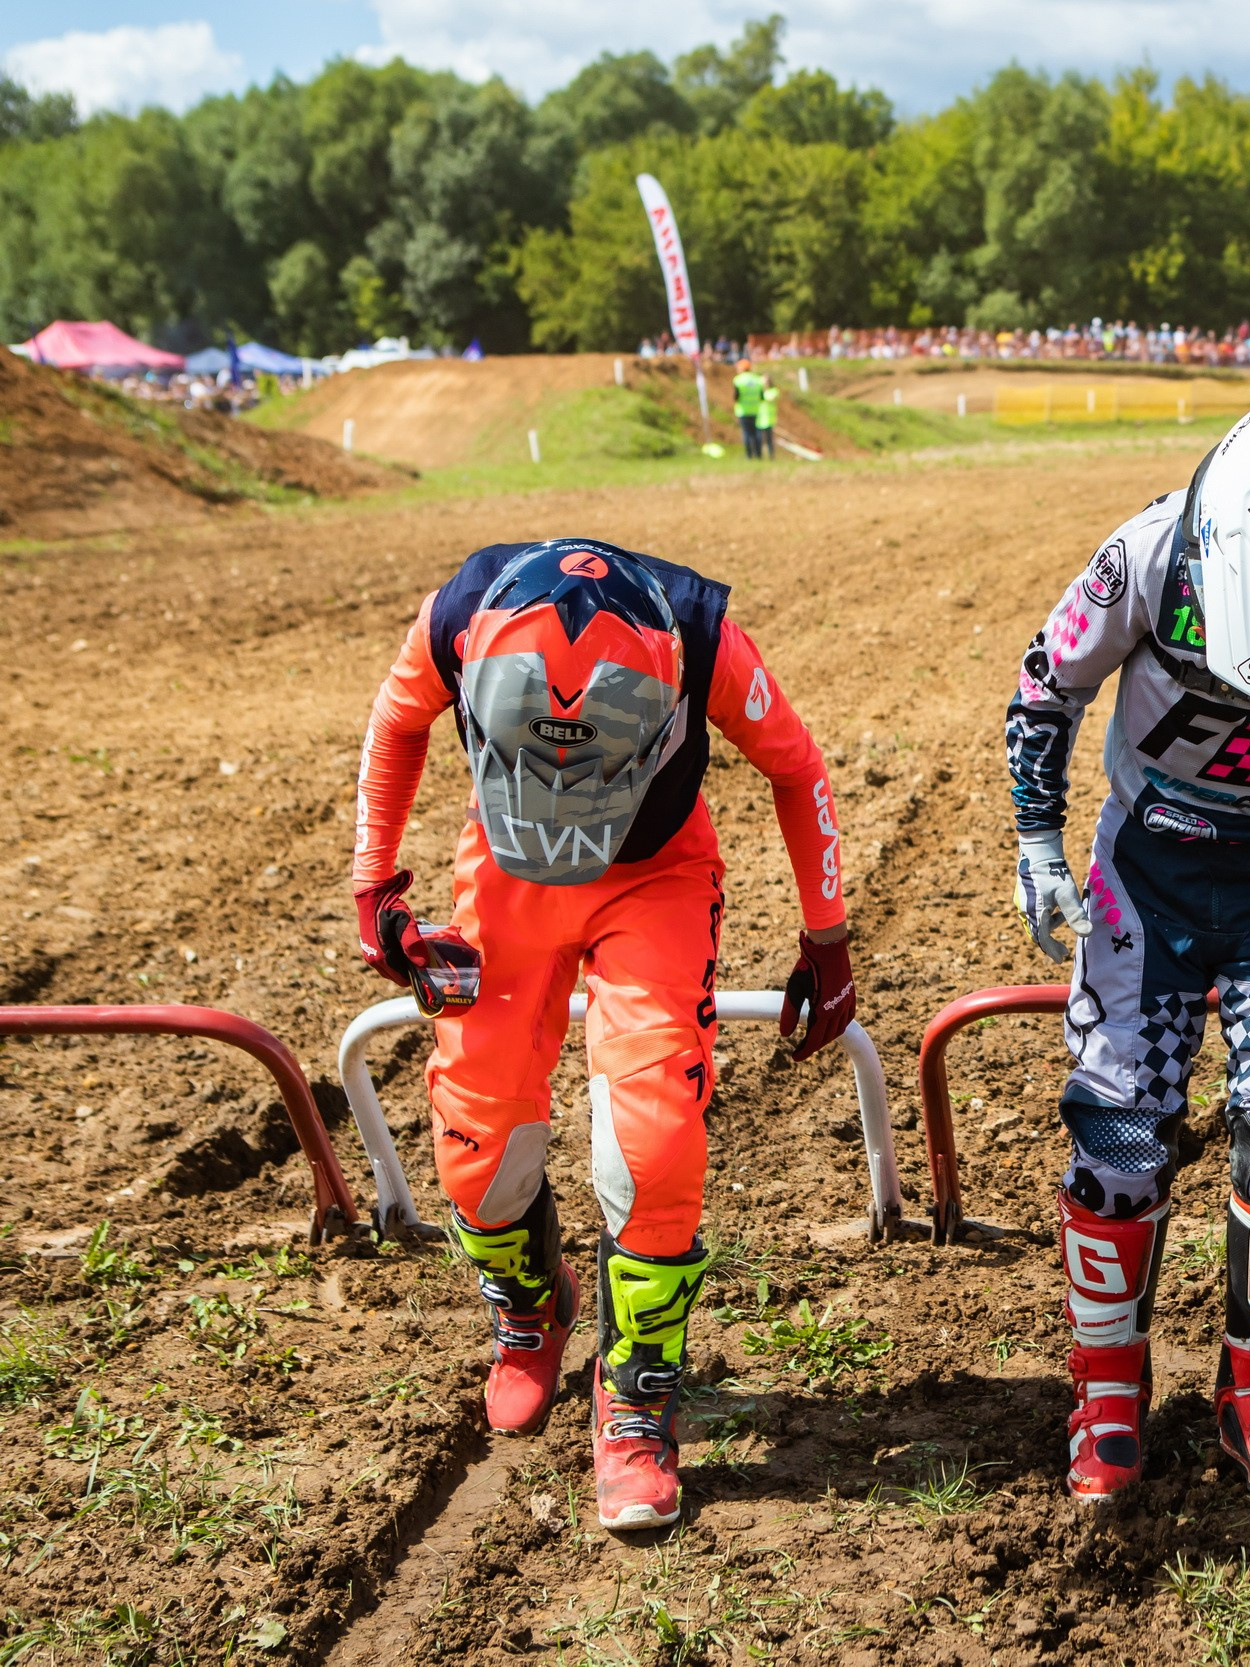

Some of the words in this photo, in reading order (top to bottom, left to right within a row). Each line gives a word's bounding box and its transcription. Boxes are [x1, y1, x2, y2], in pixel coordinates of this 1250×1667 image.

[540, 722, 587, 740] BELL
[1165, 810, 1198, 825] SPEED
[491, 813, 612, 866] SVN
[445, 996, 472, 1004] OAKLEY
[1065, 1226, 1128, 1294] G
